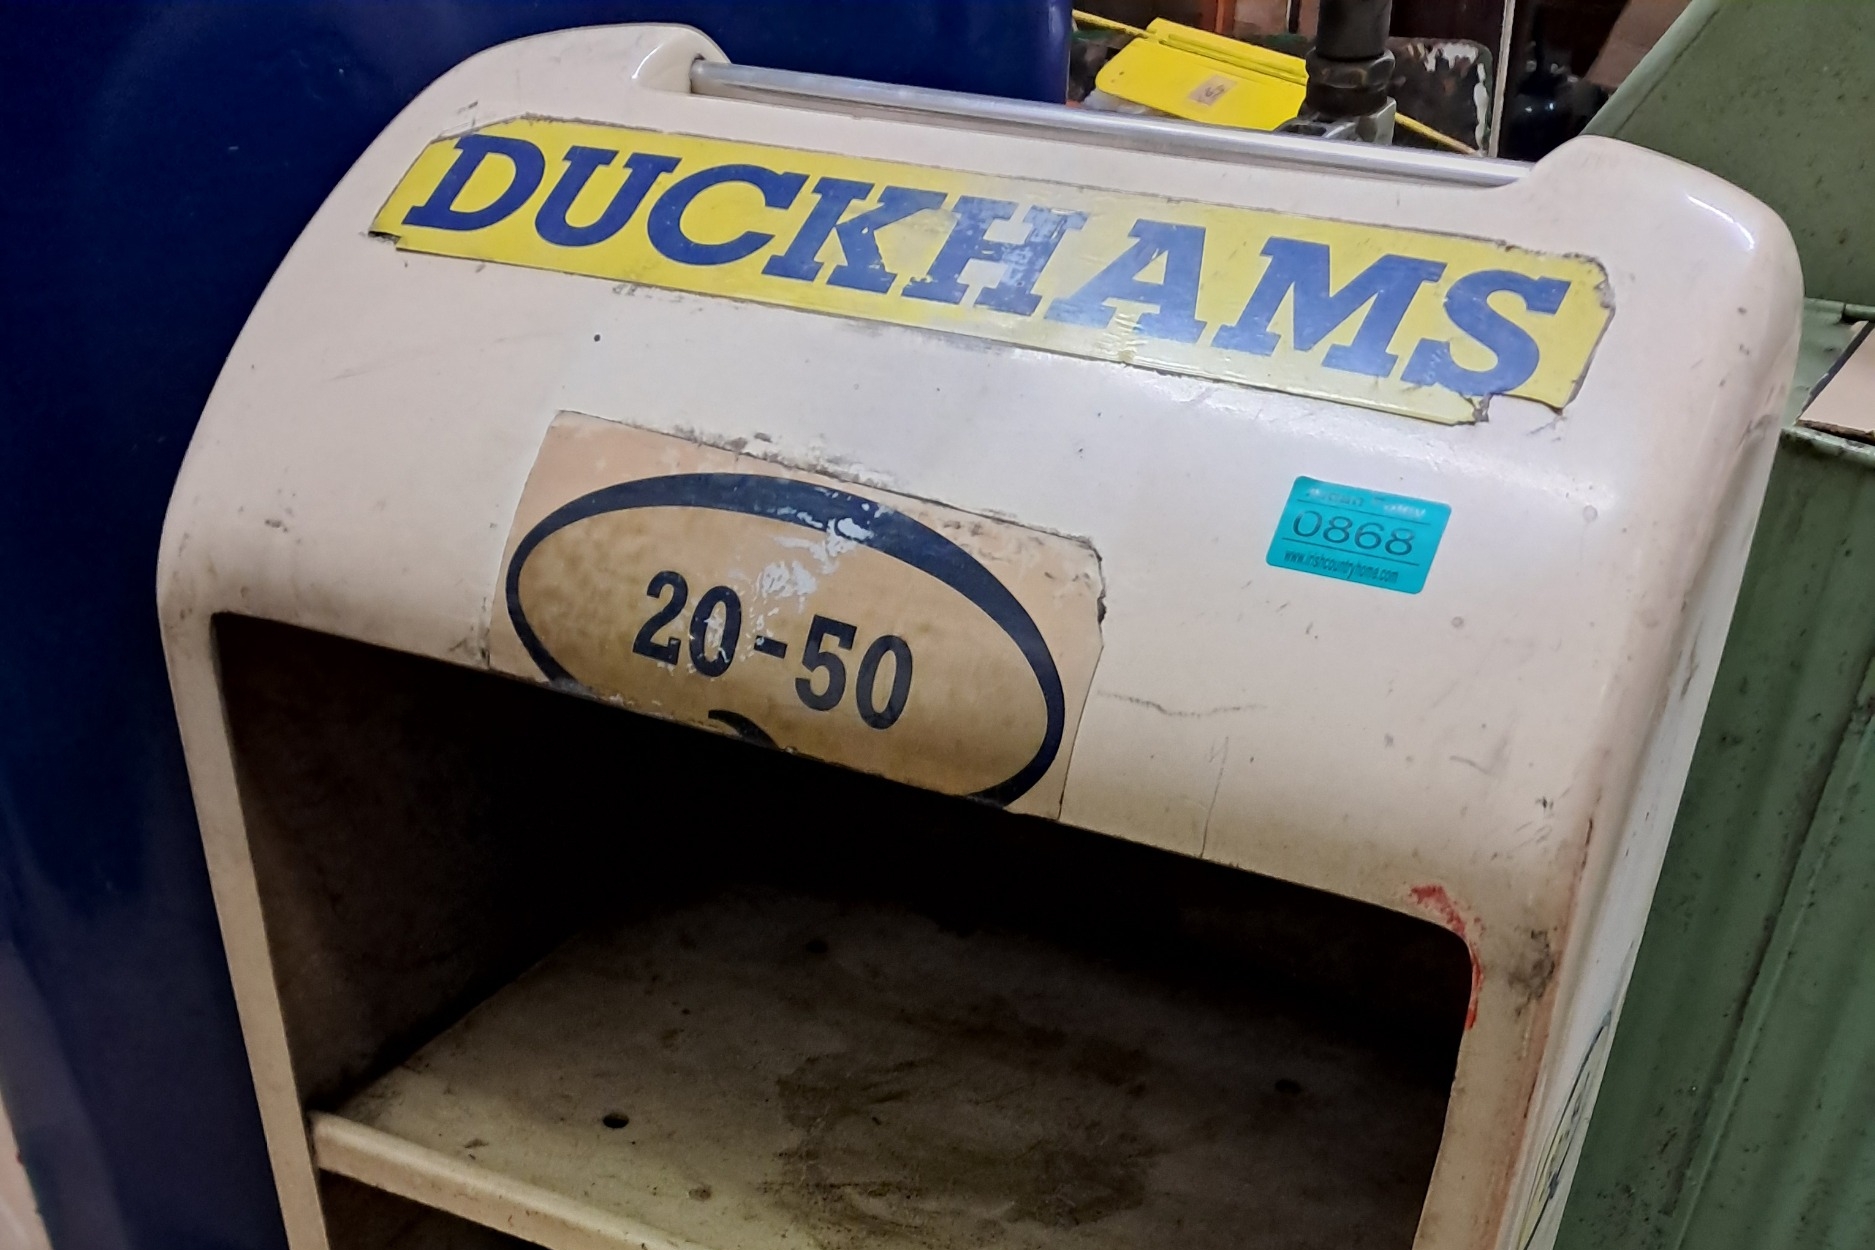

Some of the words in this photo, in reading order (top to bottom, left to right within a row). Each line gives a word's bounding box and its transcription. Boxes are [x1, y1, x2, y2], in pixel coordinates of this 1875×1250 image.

[402, 133, 1571, 397] DUCKHAMS
[1292, 510, 1416, 556] 0868
[632, 571, 914, 730] 20-50
